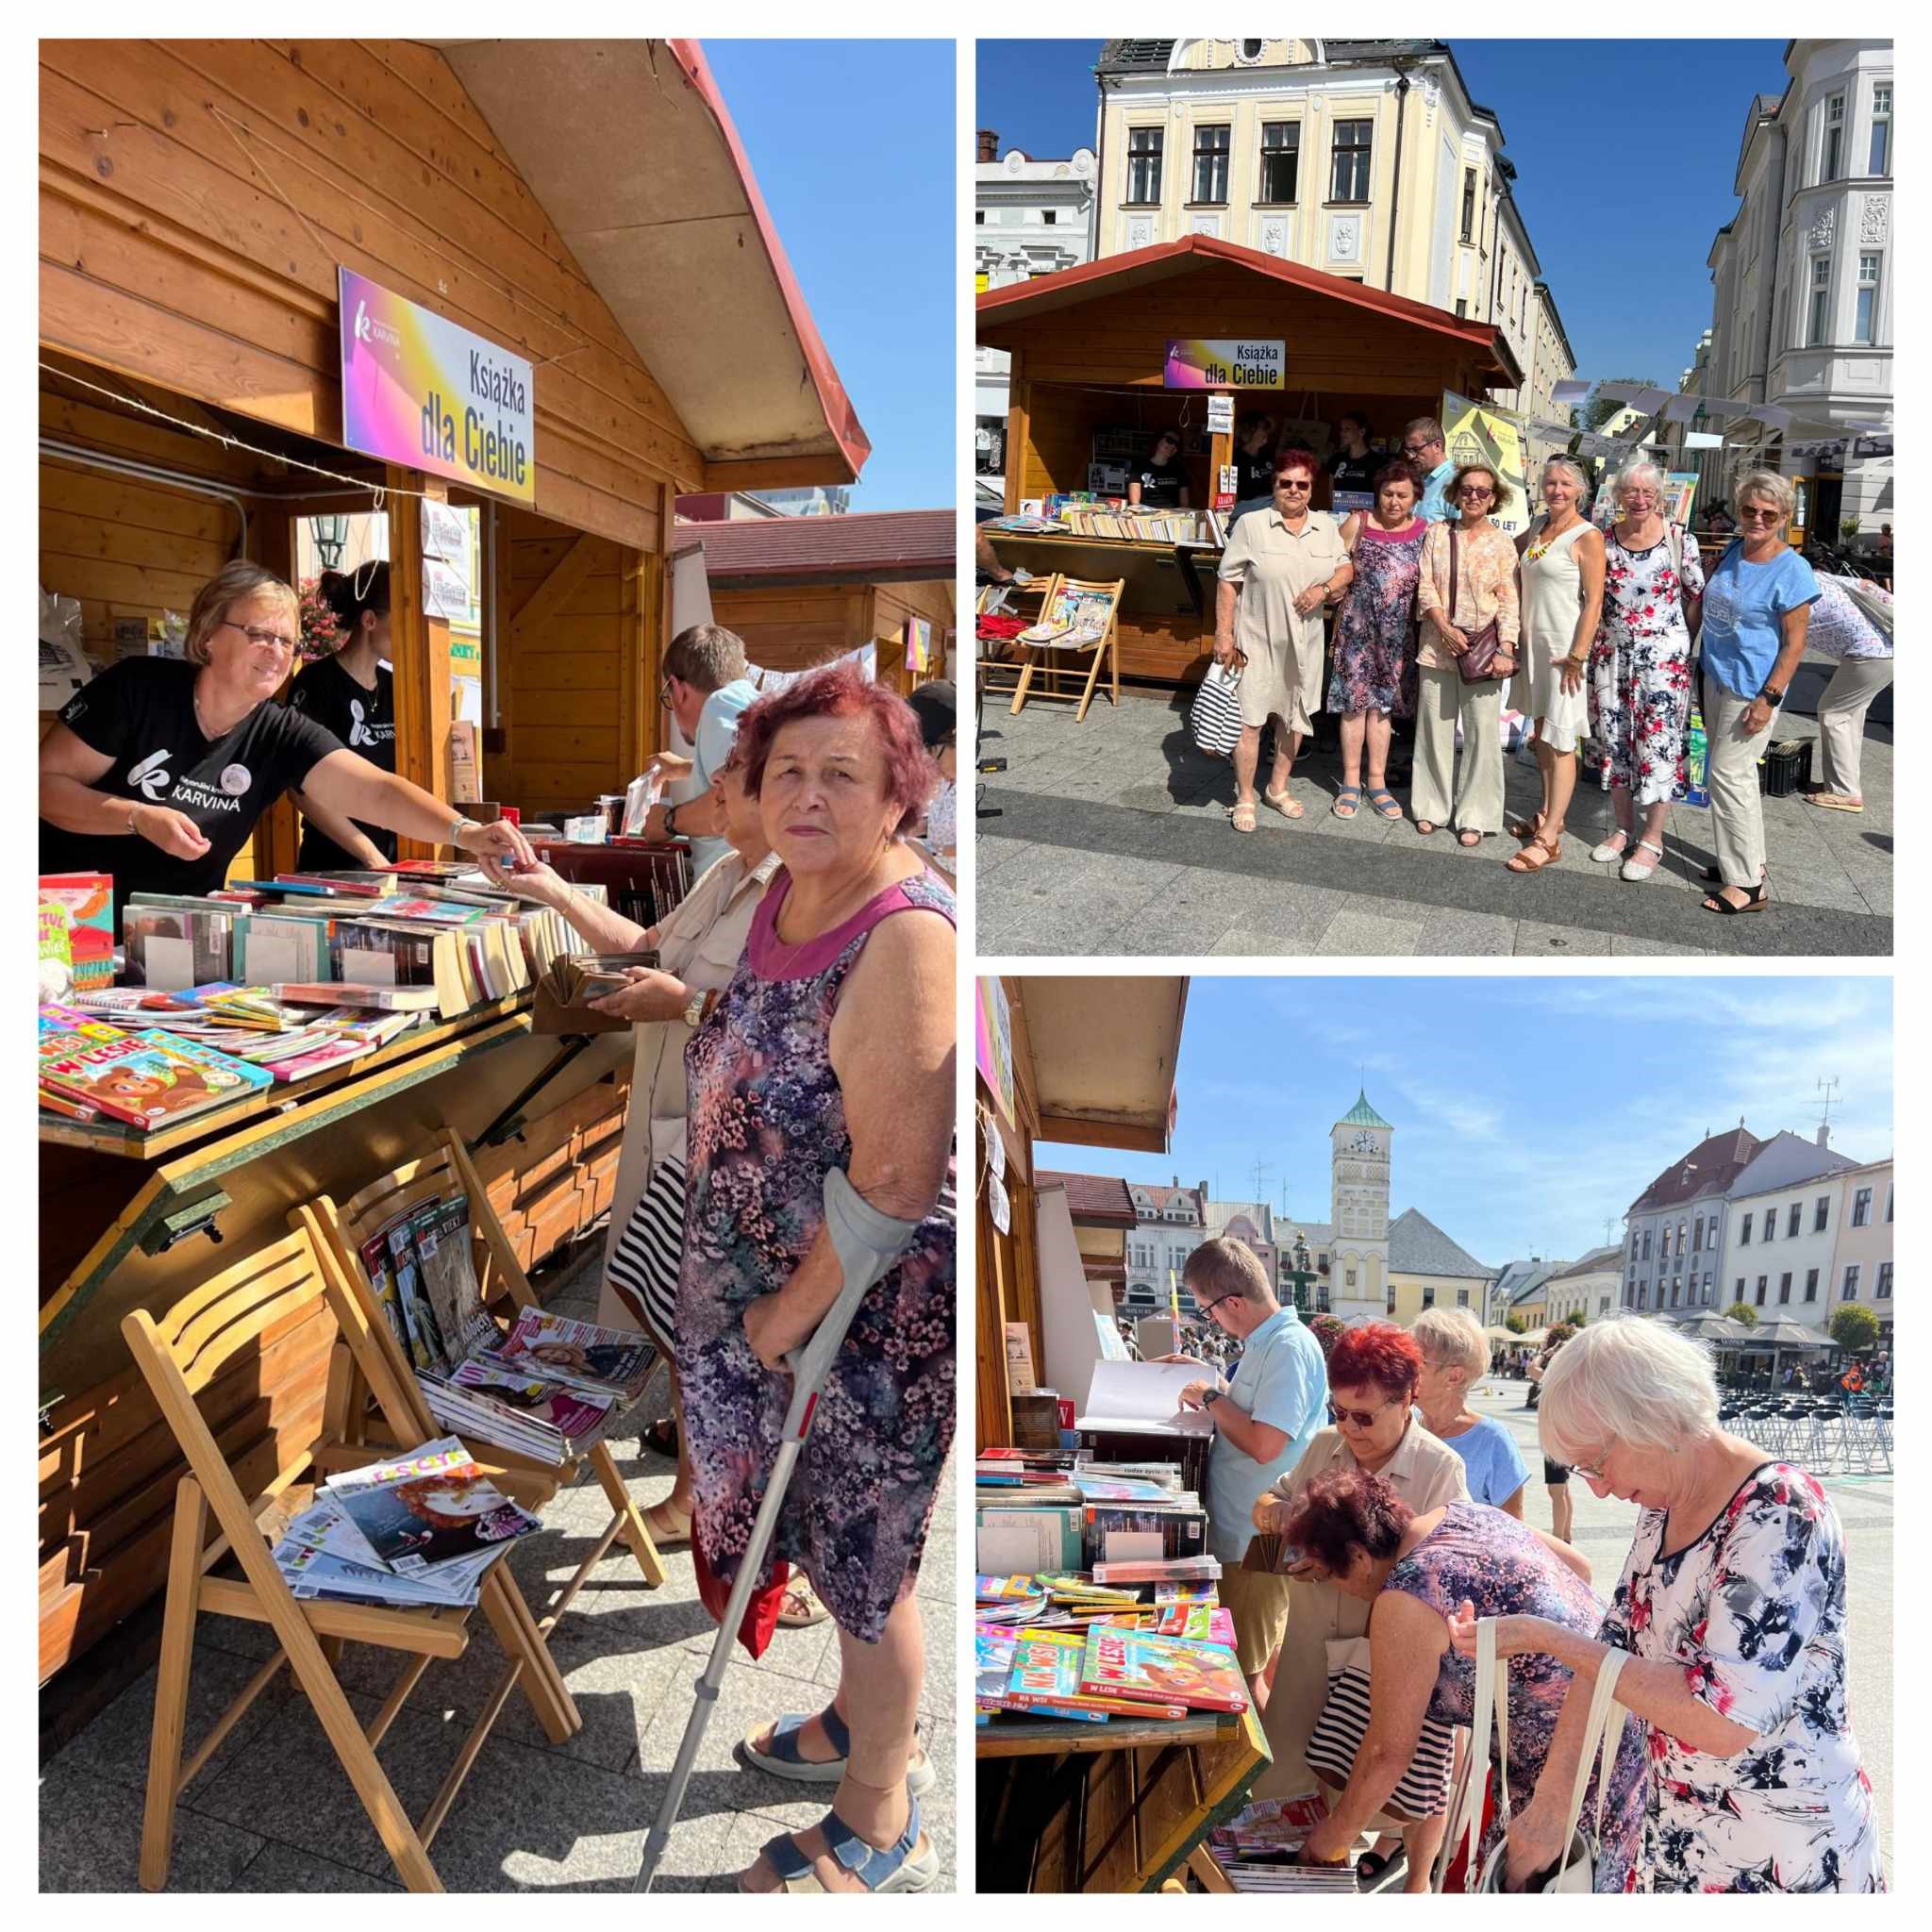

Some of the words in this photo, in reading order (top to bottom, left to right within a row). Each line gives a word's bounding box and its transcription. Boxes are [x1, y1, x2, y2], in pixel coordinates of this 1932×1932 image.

[1237, 344, 1278, 362] Książka
[470, 349, 525, 416] Książka
[1205, 363, 1226, 384] dla
[1232, 363, 1277, 385] Ciebie
[421, 391, 456, 463] dla
[464, 406, 526, 487] Ciebie
[1503, 520, 1518, 531] LET
[172, 784, 242, 812] KARVINÁ
[42, 1059, 84, 1075] W
[75, 1038, 150, 1065] LESIE
[1097, 1638, 1126, 1667] LESIE
[1096, 1666, 1127, 1679] W
